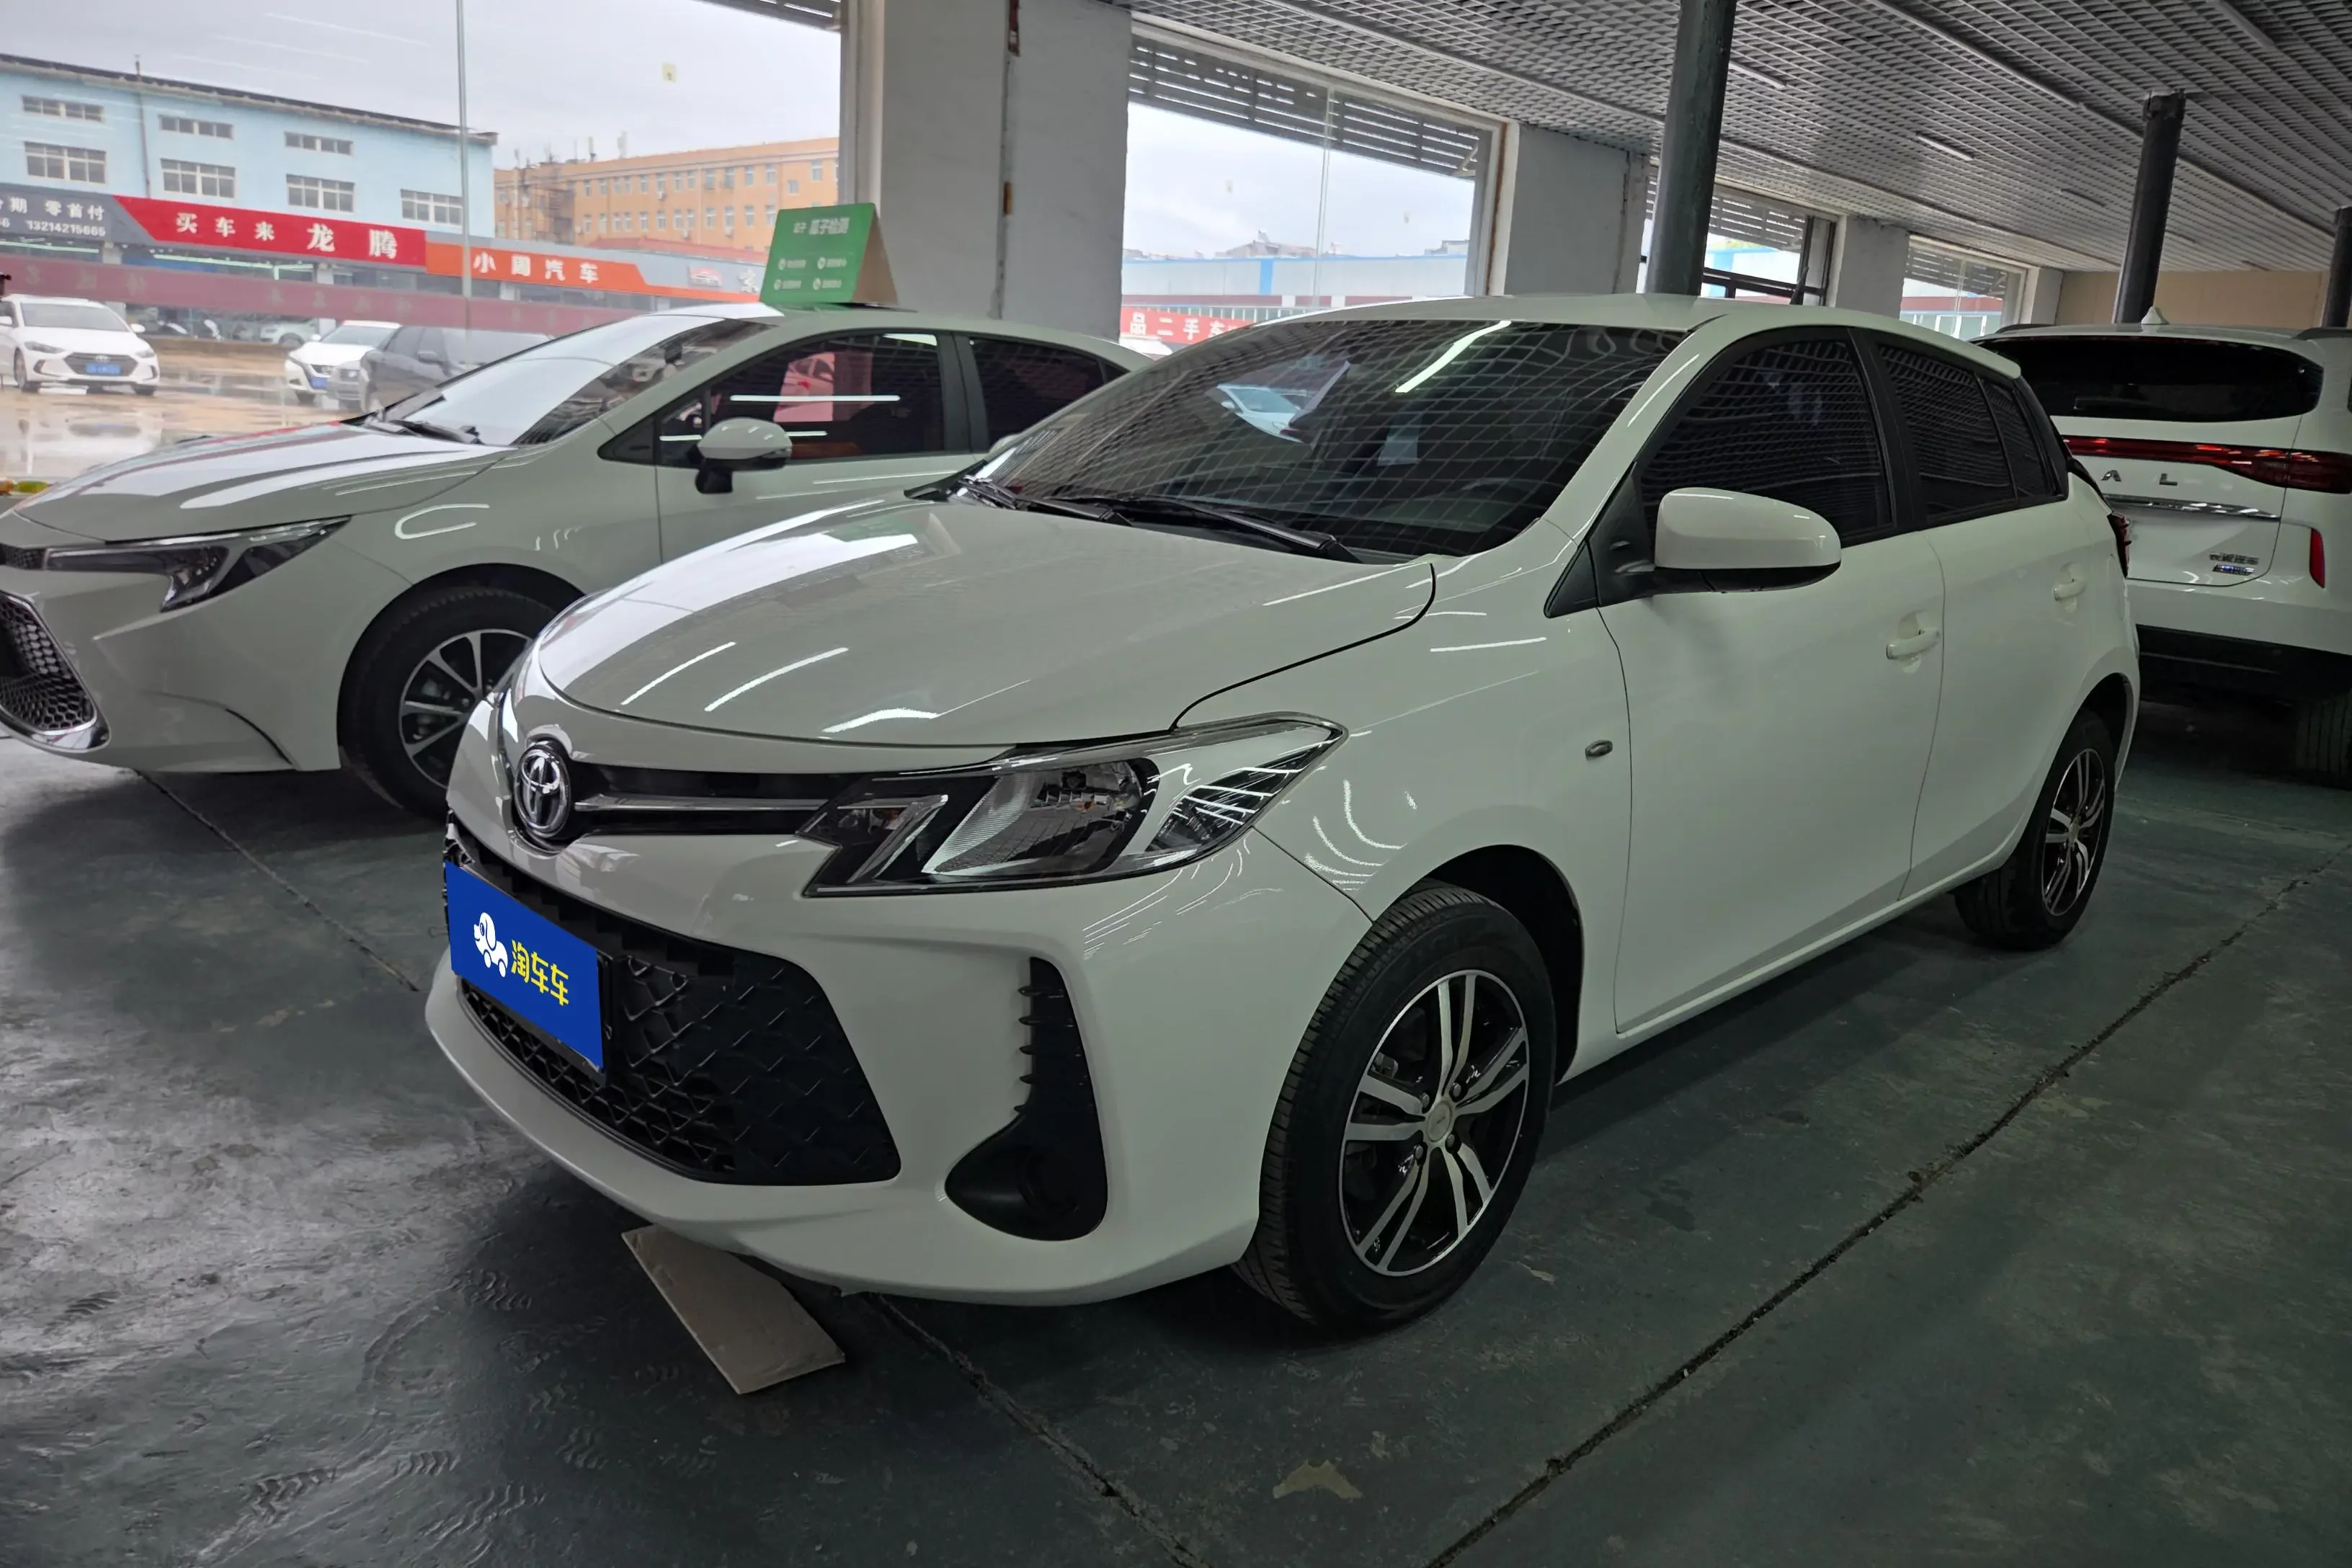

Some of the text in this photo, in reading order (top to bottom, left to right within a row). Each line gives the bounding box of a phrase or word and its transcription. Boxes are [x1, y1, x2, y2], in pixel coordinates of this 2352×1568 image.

[176, 213, 398, 259] 买车来龙腾
[1129, 311, 1239, 341] 品二手车
